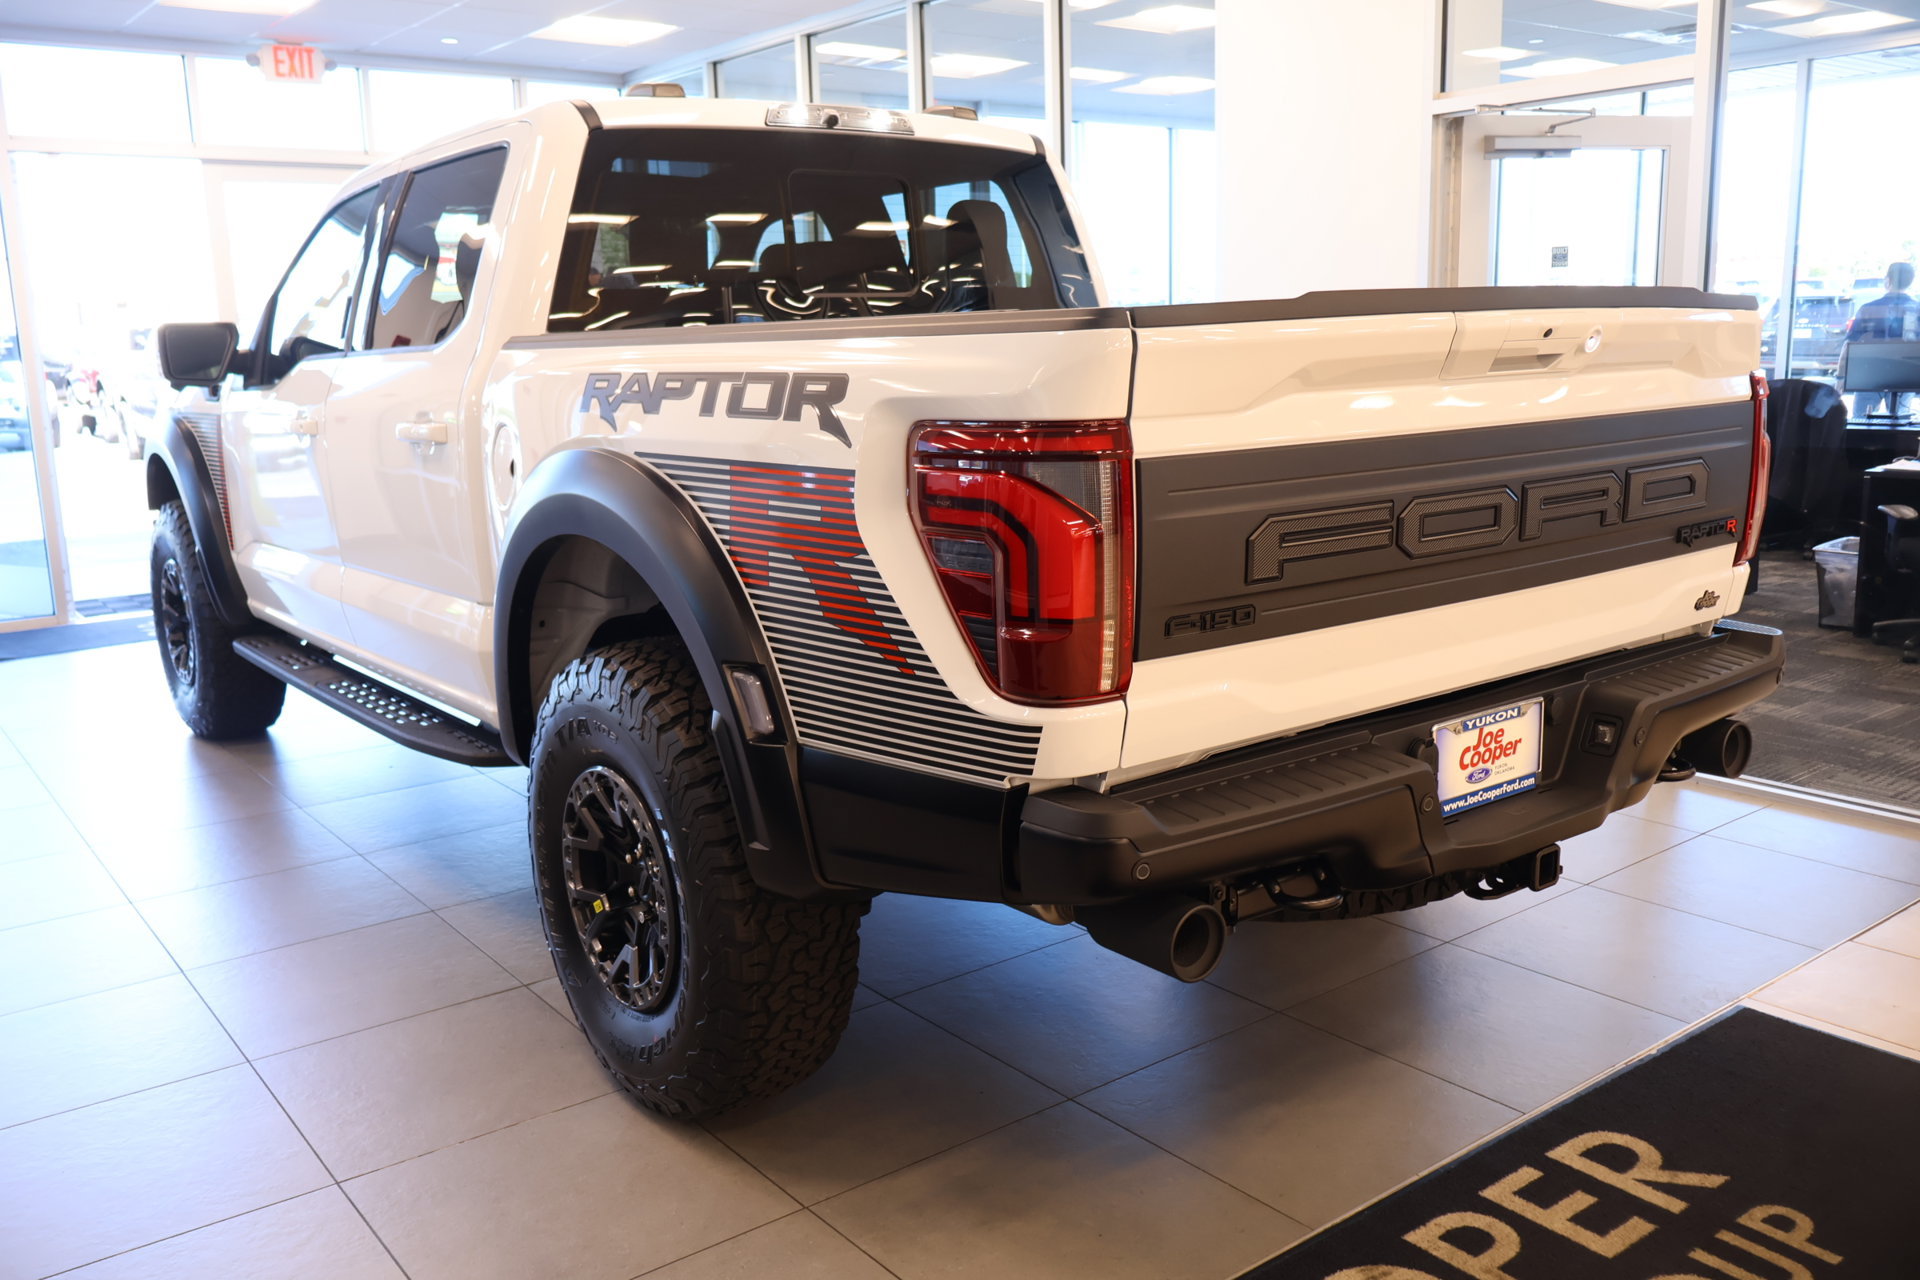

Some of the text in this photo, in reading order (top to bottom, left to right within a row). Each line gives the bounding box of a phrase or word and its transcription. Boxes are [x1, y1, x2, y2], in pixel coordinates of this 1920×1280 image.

[272, 45, 316, 79] EXIT
[579, 371, 852, 449] RAPTOR
[1245, 457, 1711, 586] FORD
[1675, 517, 1738, 547] RAPTOR
[1163, 604, 1256, 638] F-150
[1466, 707, 1519, 730] YUKON
[1459, 737, 1522, 771] Cooper
[1472, 727, 1505, 752] Joe
[1443, 776, 1536, 813] www.JoeCooperFord.com
[1323, 1130, 1731, 1280] PER
[1647, 1204, 1844, 1280] UP
